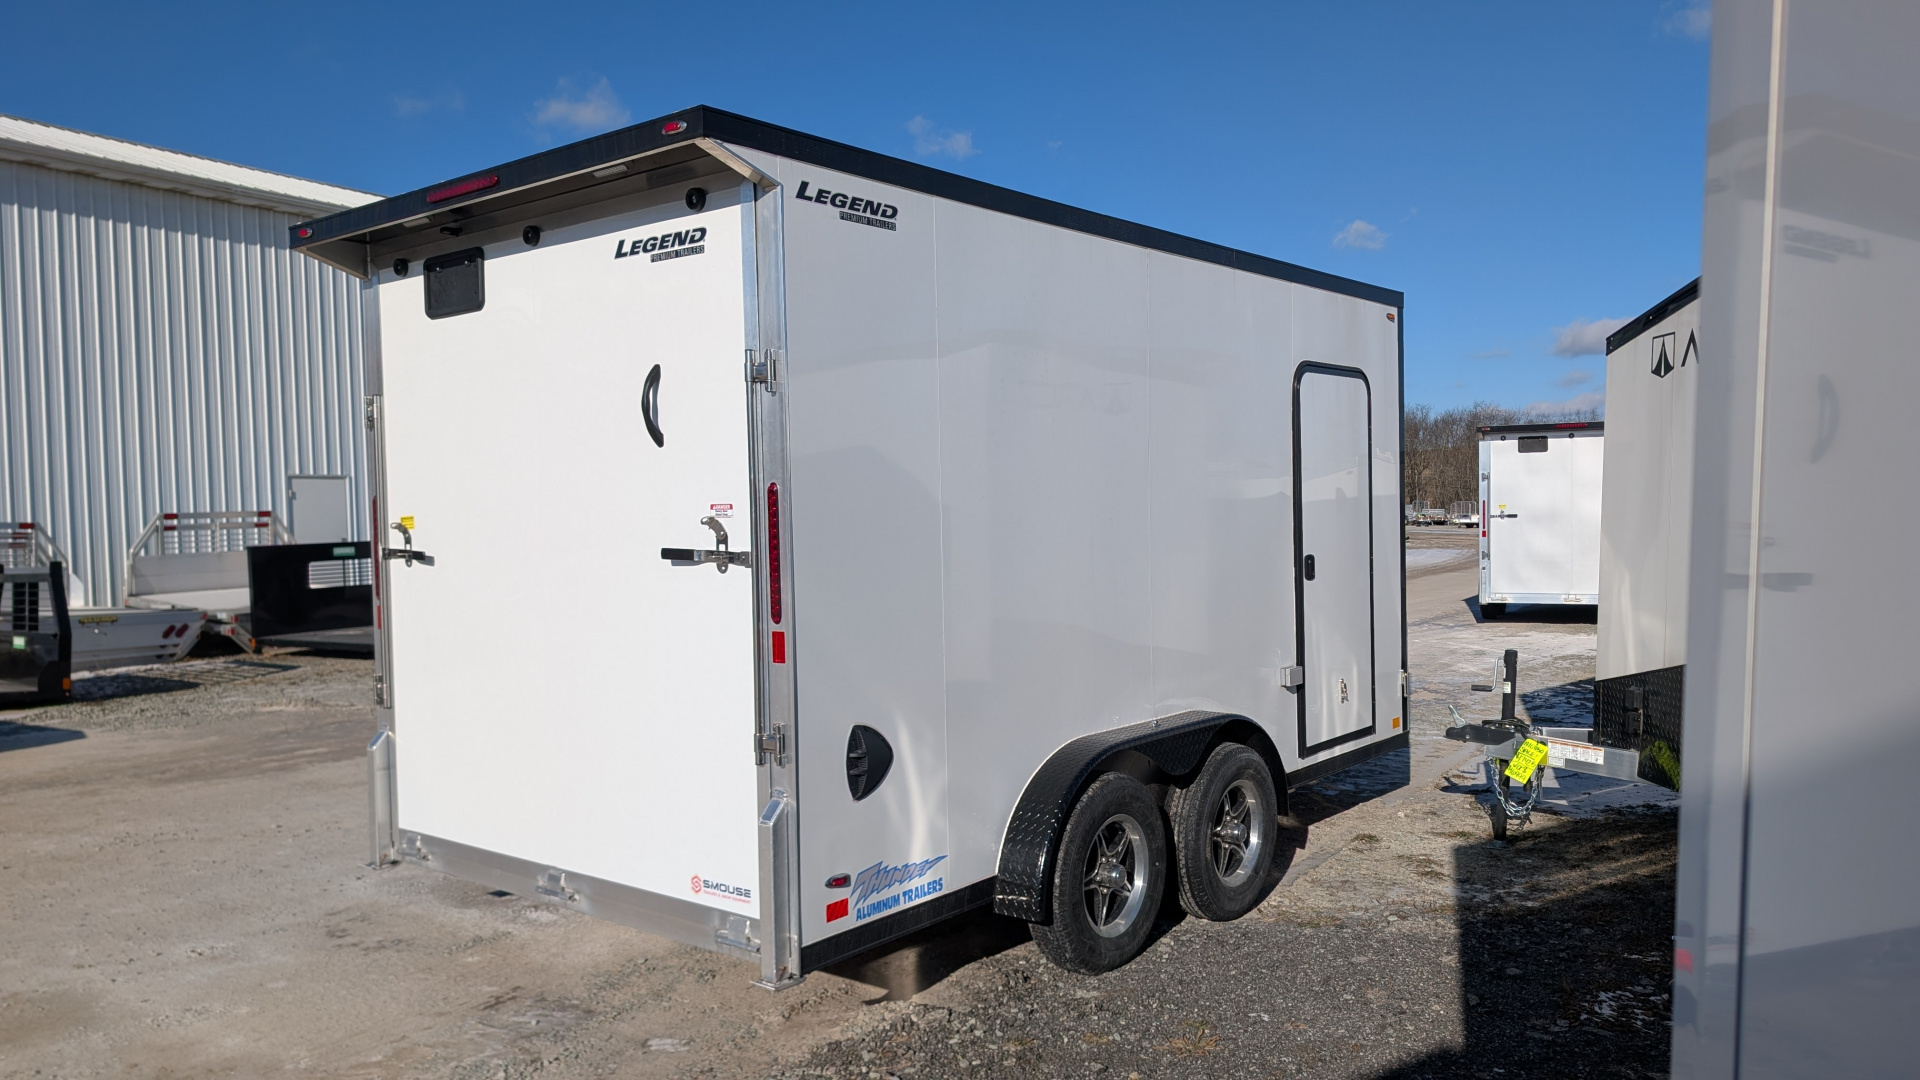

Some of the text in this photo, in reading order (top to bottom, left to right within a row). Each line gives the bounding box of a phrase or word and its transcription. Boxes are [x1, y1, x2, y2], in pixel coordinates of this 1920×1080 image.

[795, 180, 898, 219] LEGEND
[839, 211, 897, 232] PREMIUM TRAILERS
[614, 227, 707, 260] LEGEND
[651, 245, 705, 263] PREMIUM TRAILERS
[702, 879, 752, 899] SMOUSE
[856, 877, 943, 922] ALUMINUM TRAILERS
